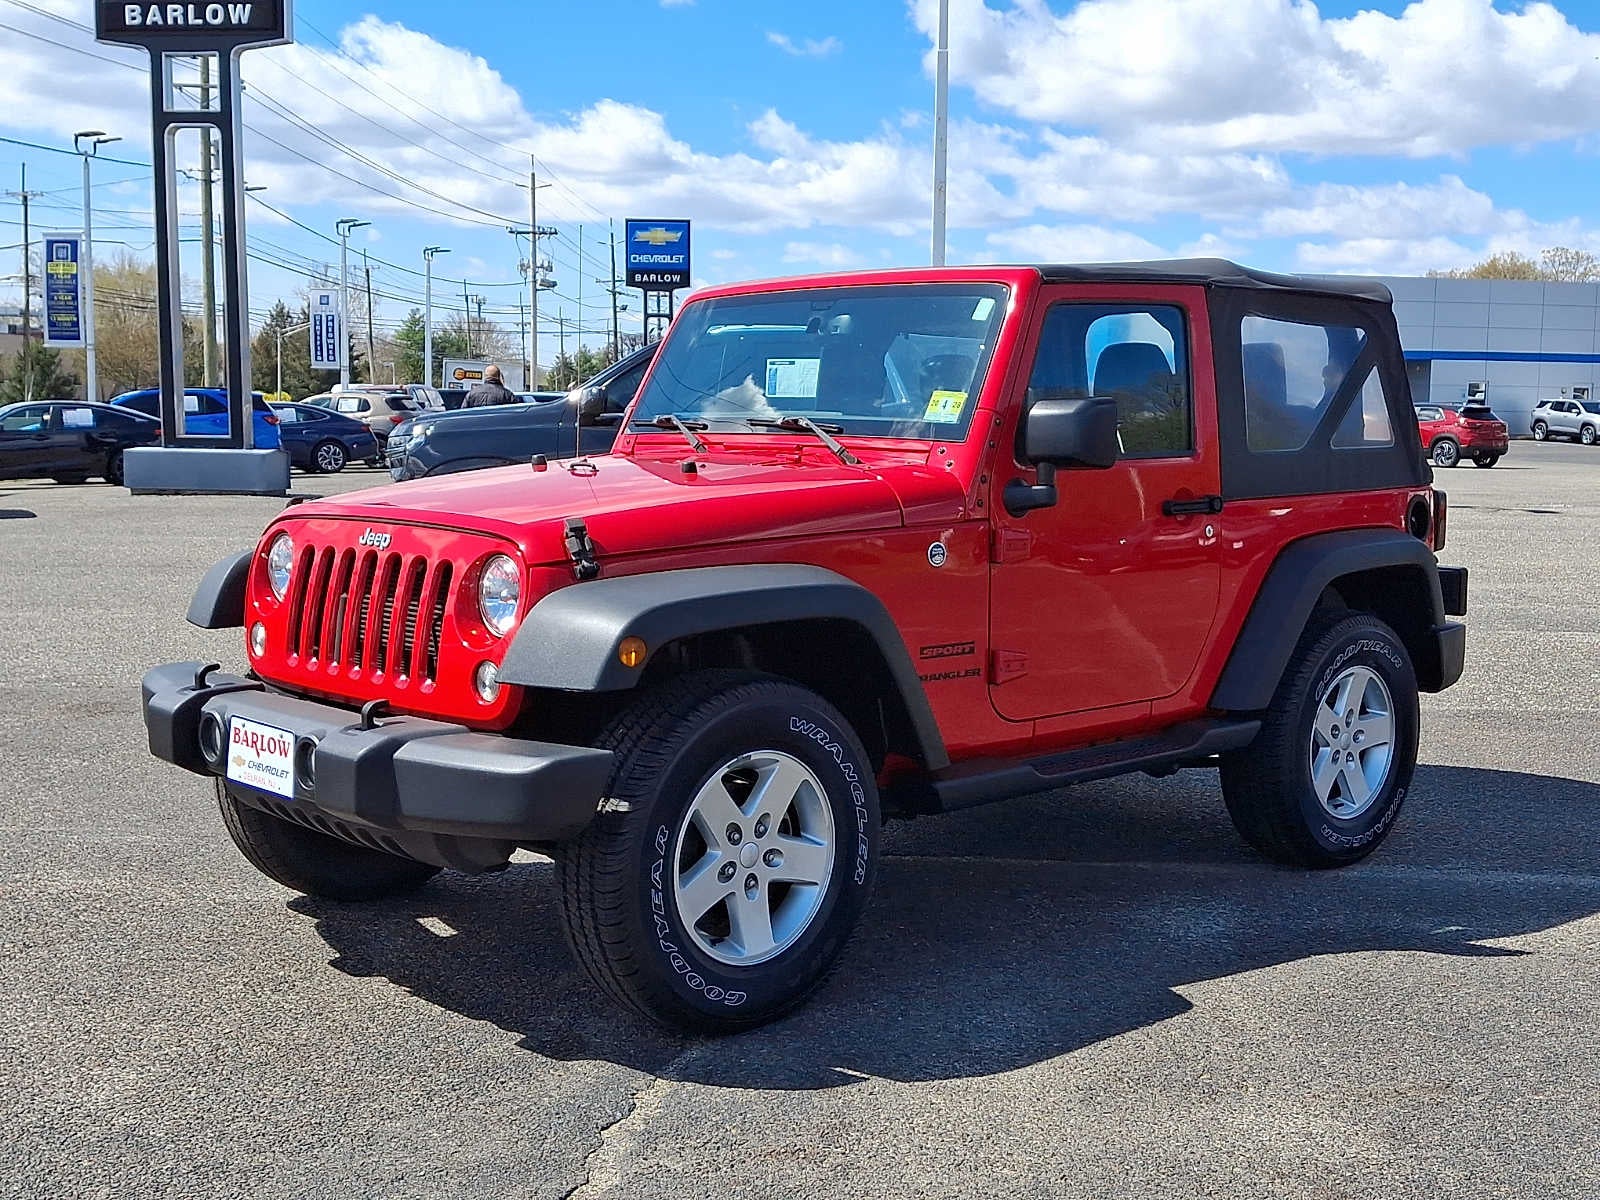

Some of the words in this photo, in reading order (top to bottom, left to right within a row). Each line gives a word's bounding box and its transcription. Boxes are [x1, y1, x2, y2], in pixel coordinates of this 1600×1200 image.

[124, 4, 252, 25] BARLOW
[630, 254, 685, 264] CHEVROLET
[634, 273, 681, 283] BARLOW
[359, 527, 392, 551] Jeep
[921, 643, 975, 657] SPORT
[918, 667, 981, 681] RANGLER
[1315, 639, 1403, 702] GOODYEAR
[233, 727, 290, 758] BARLOW
[248, 760, 289, 779] CHEVROLET
[790, 716, 870, 886] WRANGLER
[649, 824, 747, 1006] GOODYEAR
